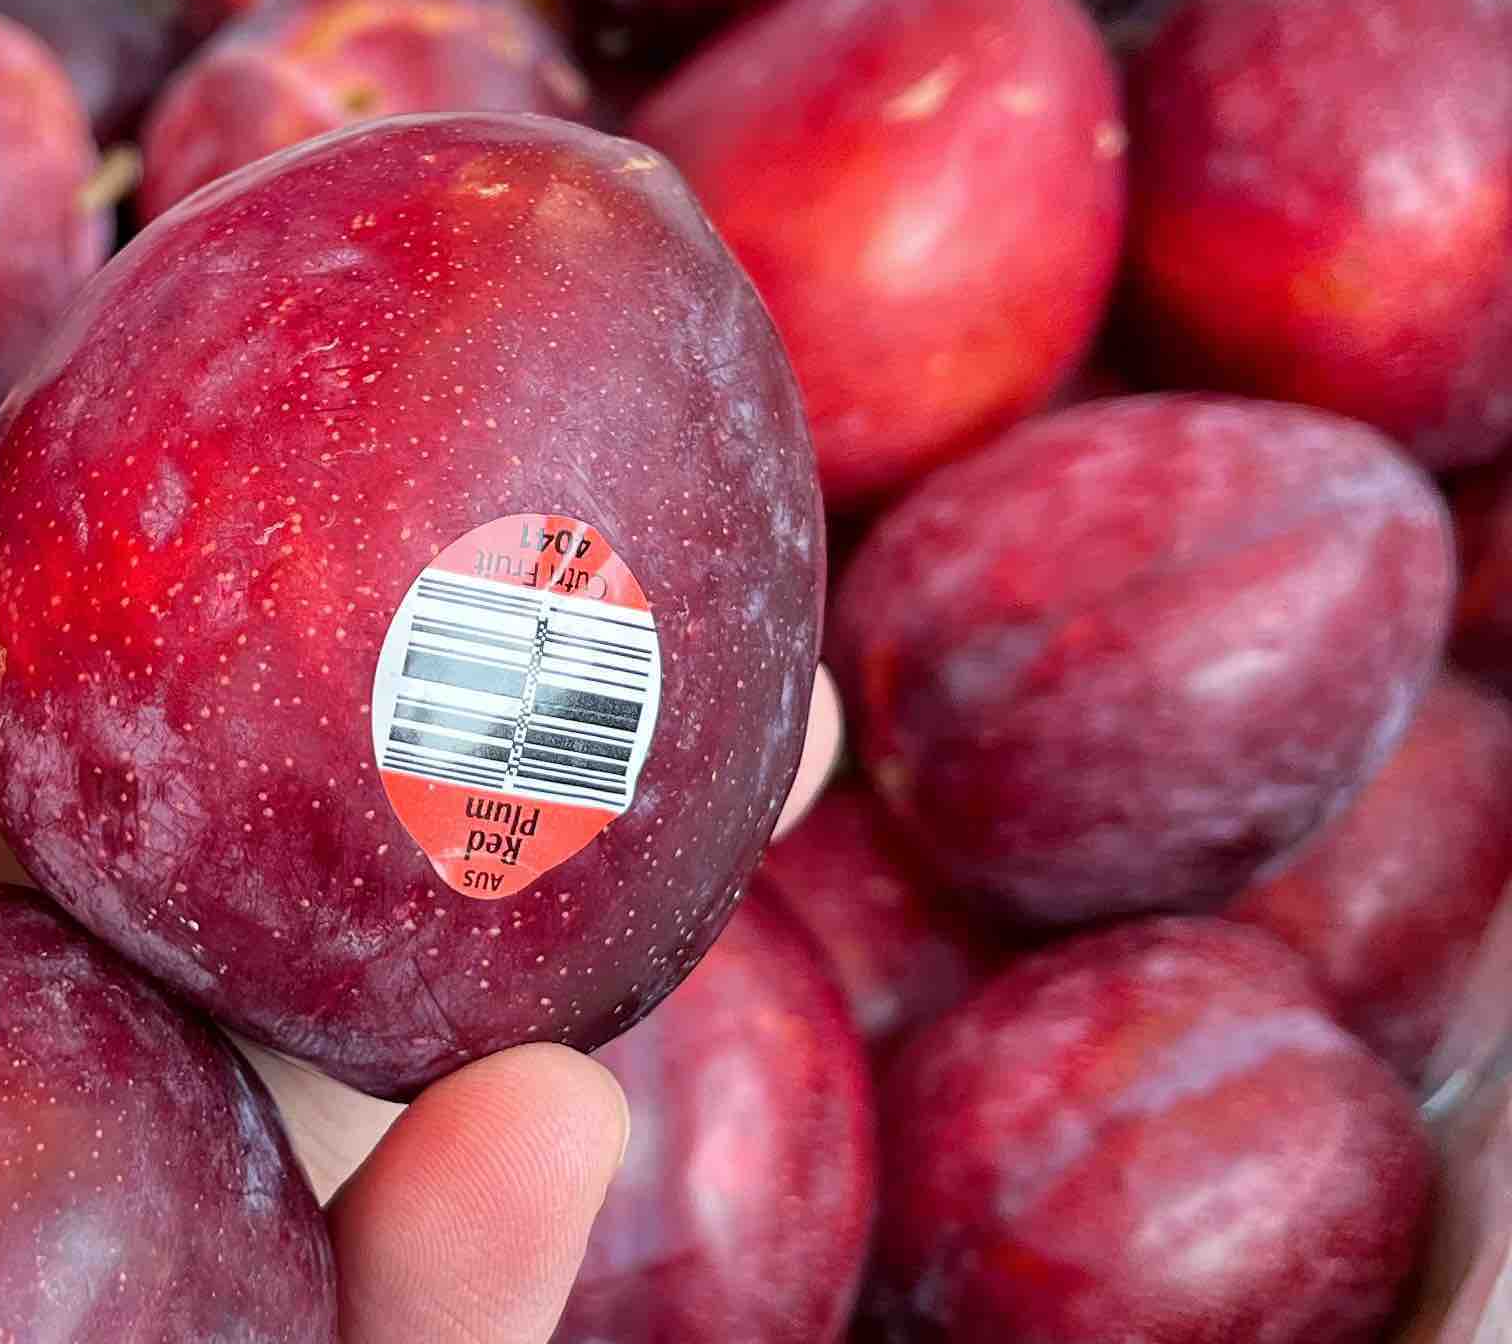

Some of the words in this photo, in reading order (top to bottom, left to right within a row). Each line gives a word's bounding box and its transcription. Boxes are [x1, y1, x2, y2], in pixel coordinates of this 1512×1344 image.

[520, 528, 592, 558] 4041
[474, 549, 539, 588] Fruit
[466, 797, 540, 836] Plum
[464, 830, 522, 866] Red
[463, 870, 505, 891] AUS
